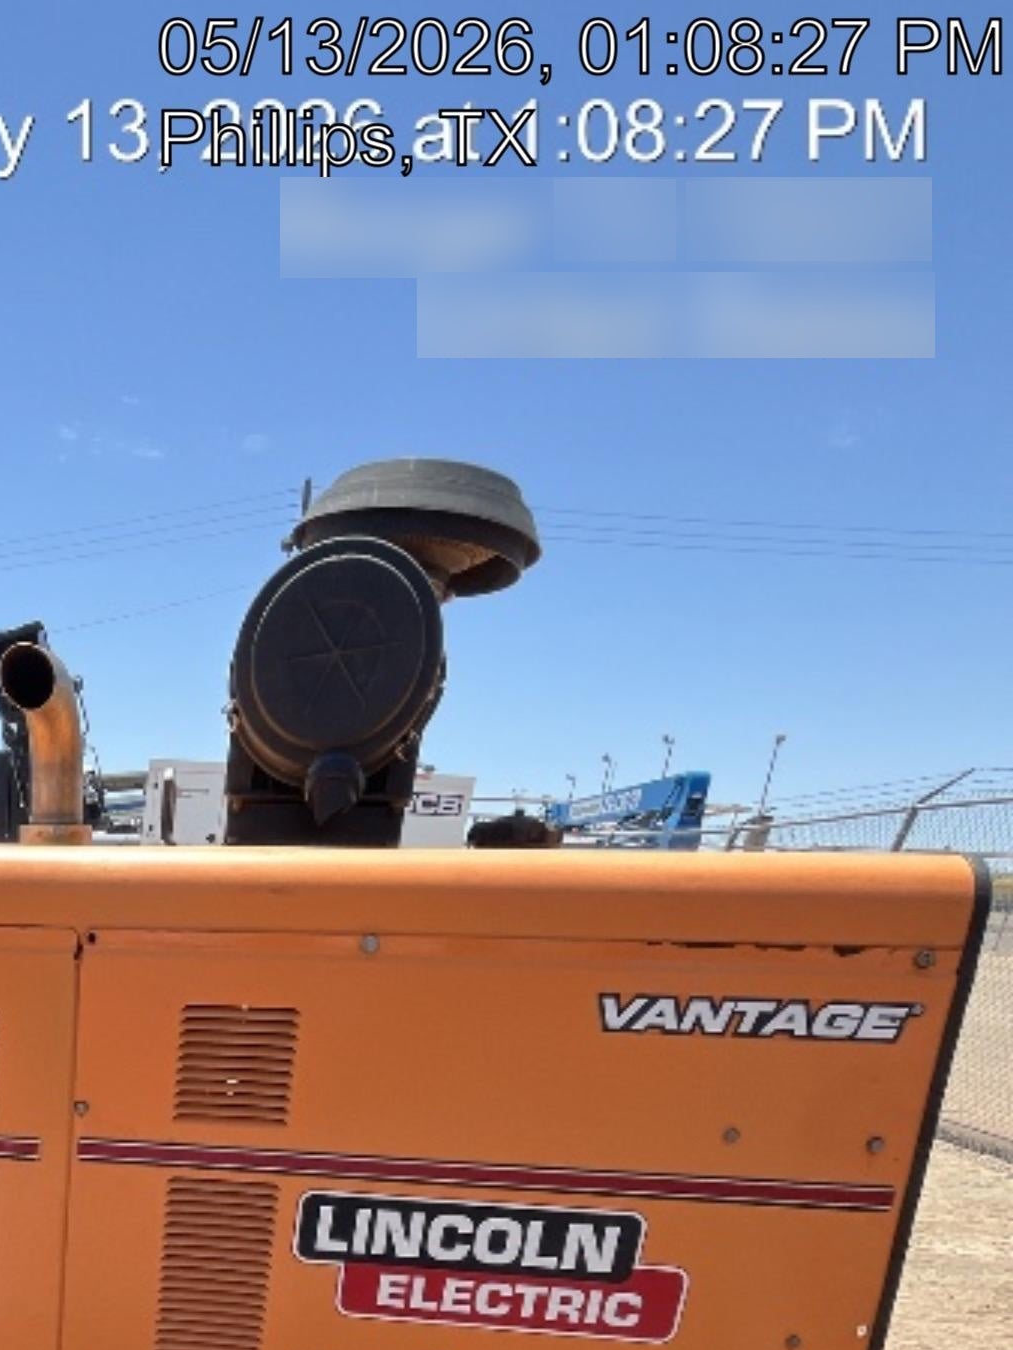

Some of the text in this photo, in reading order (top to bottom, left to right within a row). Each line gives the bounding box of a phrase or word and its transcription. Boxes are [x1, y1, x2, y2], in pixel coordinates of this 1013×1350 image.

[599, 995, 910, 1042] VANTAGE
[313, 1204, 622, 1274] LINCOLN
[375, 1273, 644, 1328] ELECTRIC
